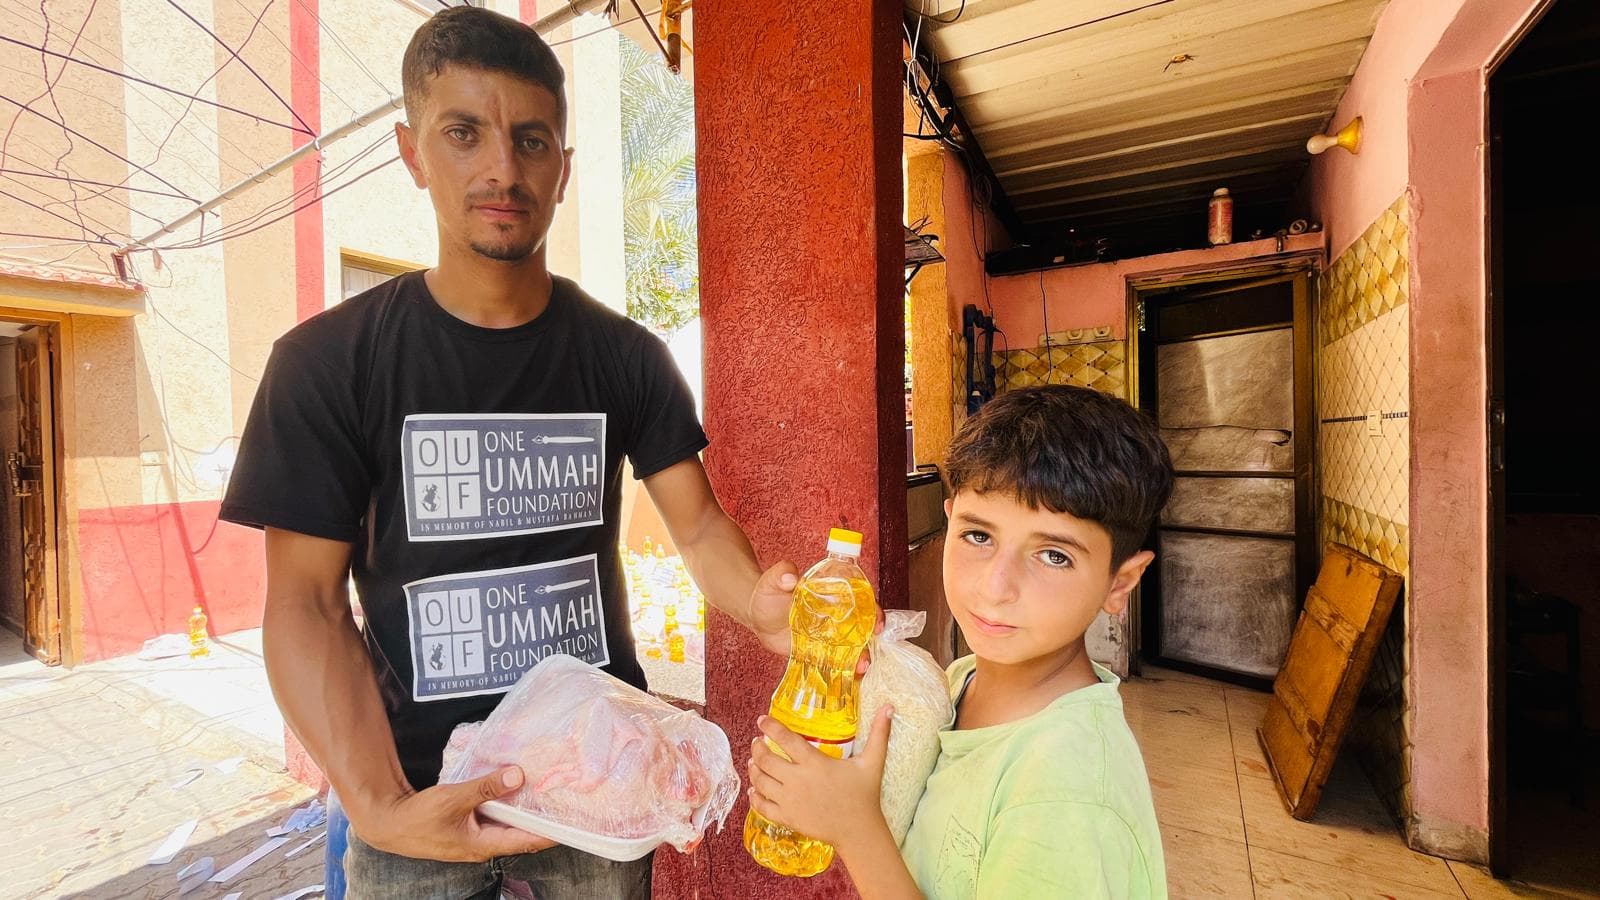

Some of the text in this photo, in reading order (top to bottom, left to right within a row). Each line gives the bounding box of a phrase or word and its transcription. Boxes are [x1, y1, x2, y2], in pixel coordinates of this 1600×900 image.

[419, 437, 471, 467] O U
[484, 431, 525, 453] ONE
[485, 454, 598, 492] UMMAH
[458, 482, 470, 510] F
[487, 490, 597, 516] FOUNDATION
[421, 523, 430, 532] IN
[434, 521, 471, 531] MEMORY
[474, 520, 486, 529] OF
[489, 518, 514, 528] NABIL
[526, 514, 560, 525] MUSTAFA
[486, 583, 528, 609] ONE
[425, 596, 473, 627] O U
[487, 594, 596, 648] UMMAH
[462, 640, 473, 668] F
[490, 631, 598, 672] FOUNDATION
[428, 672, 517, 691] IN MEMORY OF NABIL
